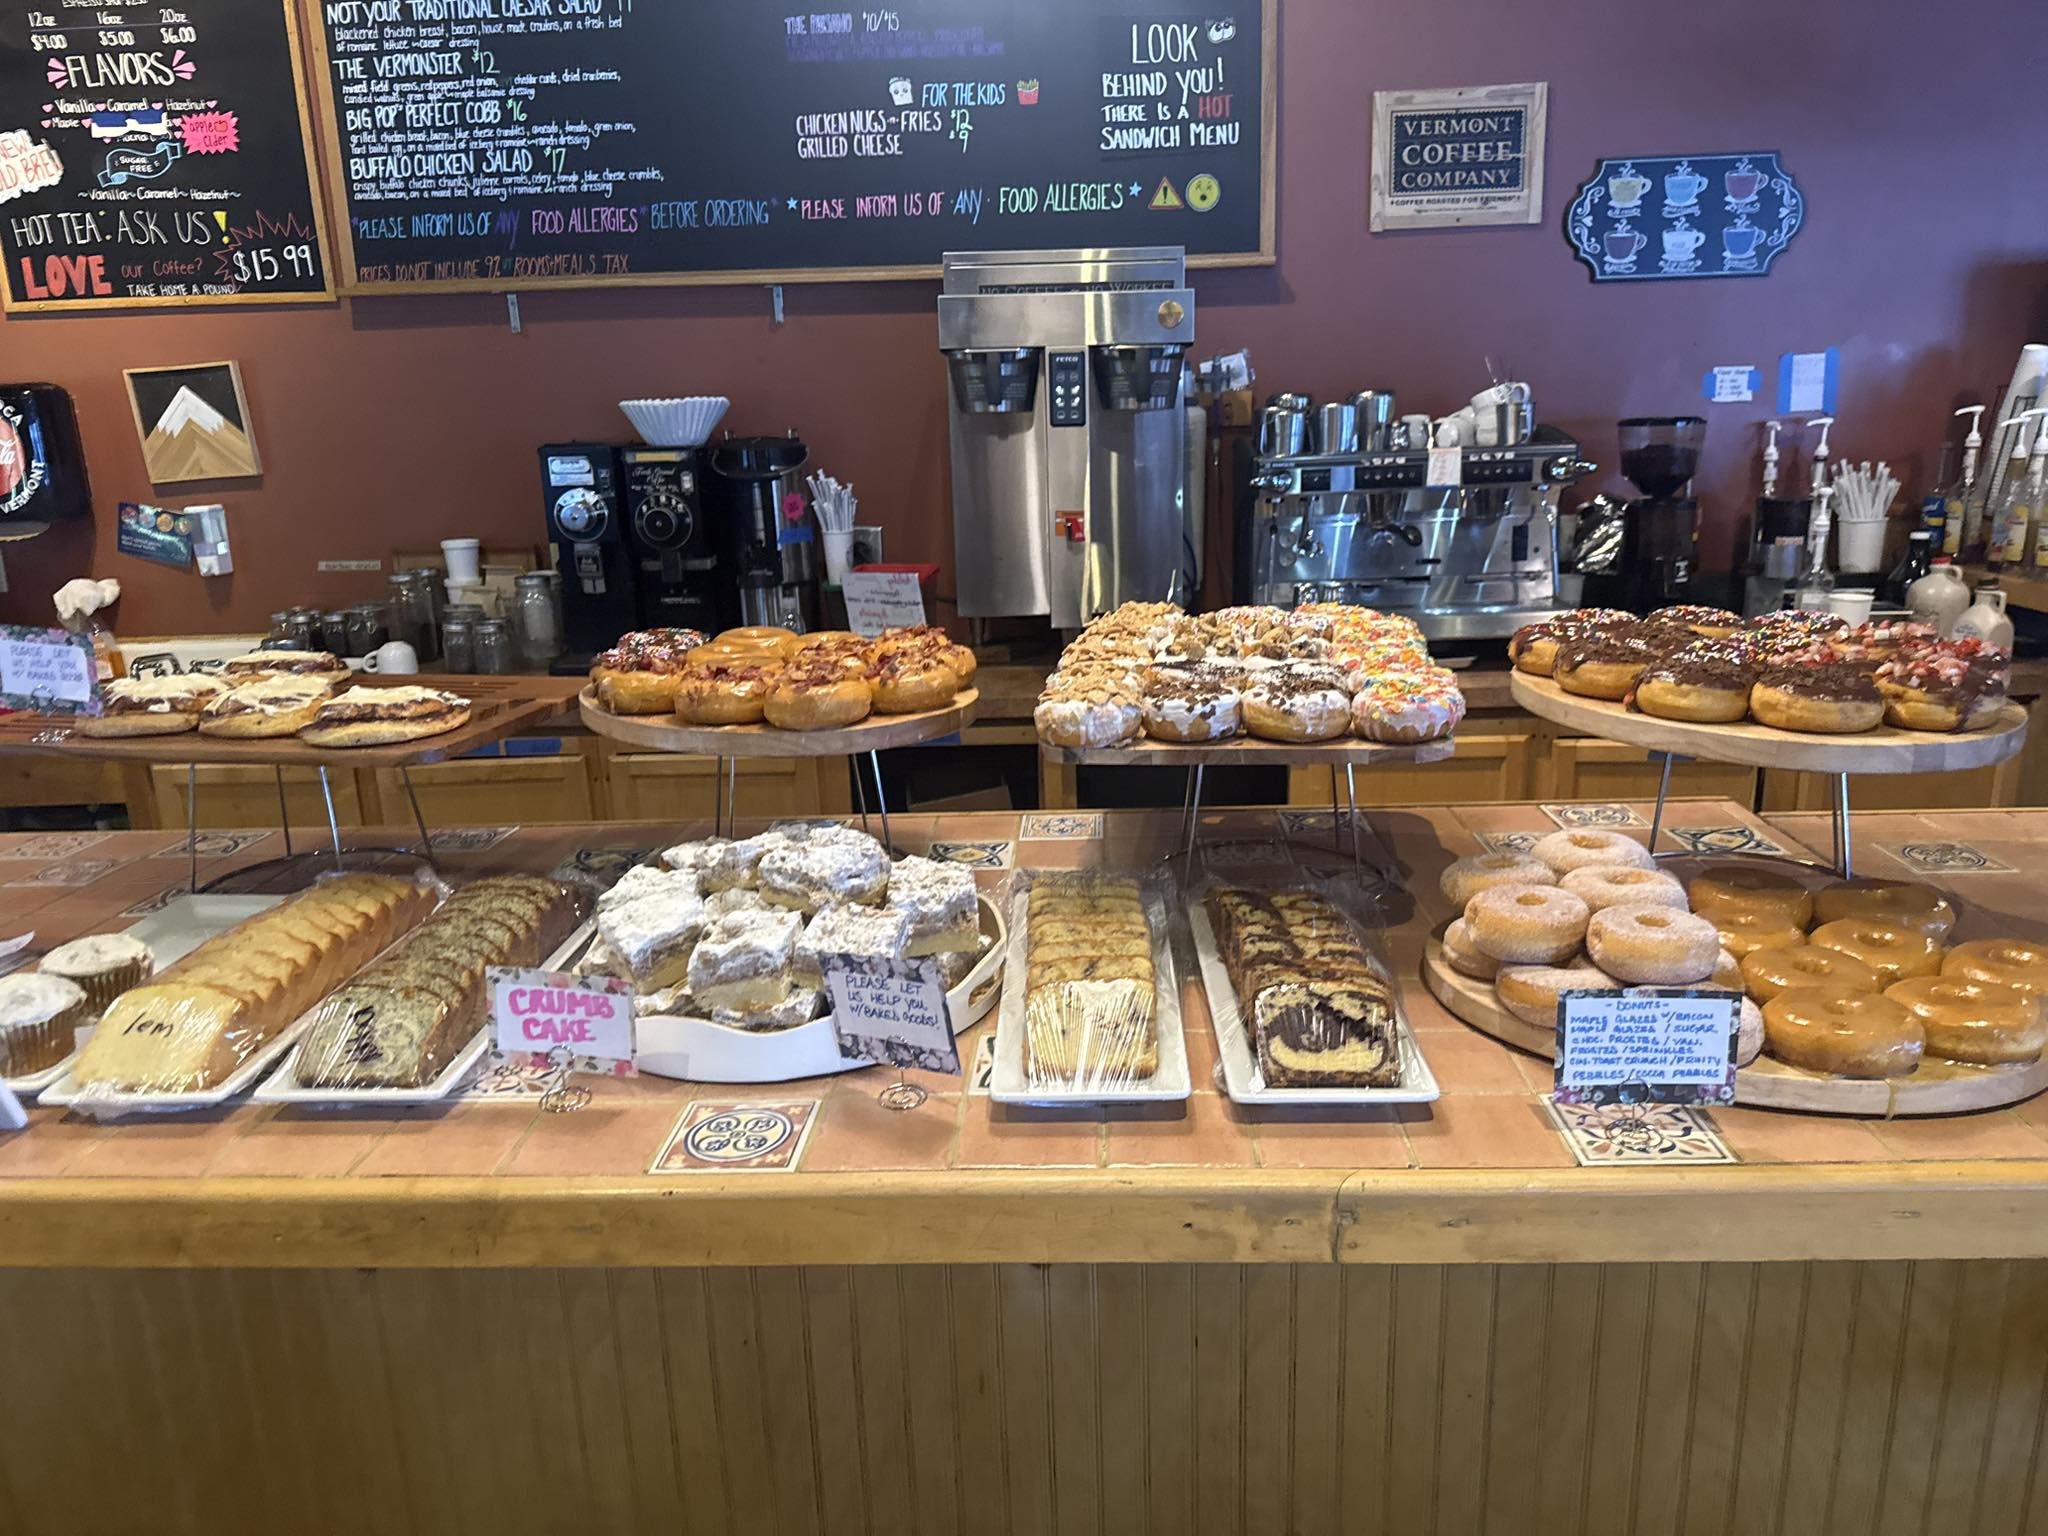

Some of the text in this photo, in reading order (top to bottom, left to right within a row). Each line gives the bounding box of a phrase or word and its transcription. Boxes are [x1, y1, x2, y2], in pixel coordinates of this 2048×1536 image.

[327, 2, 361, 25] NOT
[362, 1, 400, 27] YOUR
[406, 0, 497, 20] TRADITIONAL
[502, 0, 552, 17] CAESAR
[1132, 24, 1198, 64] LOOK
[65, 53, 175, 88] FLAVORS
[332, 49, 500, 80] THE VERMONSTER $12
[1102, 57, 1224, 104] BEHIND YOU!
[55, 97, 206, 114] Vanilla Caramel Hazelnut
[922, 83, 1005, 107] FOR THE KIDS
[346, 107, 372, 131] BIG
[406, 102, 461, 127] PERFECT
[465, 102, 501, 124] COBB
[506, 98, 528, 122] $16
[1101, 104, 1147, 122] THERE
[1177, 105, 1189, 119] A
[1199, 95, 1233, 118] HOT
[189, 120, 214, 133] apple
[796, 112, 847, 136] CHICKEN
[850, 110, 886, 134] NUGS
[901, 110, 942, 132] FRIES
[1100, 121, 1239, 150] SANDWICH MENU
[1404, 116, 1515, 136] VERMONT
[797, 135, 847, 158] GRILLED
[853, 134, 903, 156] CHEESE
[1402, 141, 1513, 165] COFFEE
[119, 156, 148, 164] SUGAR
[129, 164, 153, 173] FREE
[350, 147, 567, 180] BUFFALO CHICKEN SALAD $17
[1401, 169, 1511, 188] COMPANY
[90, 188, 128, 200] Vanilla
[136, 187, 178, 199] Caramel
[801, 183, 1123, 224] PLEASE INFORM US OF ANY FOOD ALLERGIES
[11, 214, 54, 247] HOT
[117, 210, 168, 245] ASK
[174, 210, 229, 245] US!
[360, 217, 407, 239] PLEASE
[411, 213, 453, 237] INFORM
[458, 212, 475, 236] US
[476, 211, 492, 236] OF
[532, 208, 564, 236] FOOD
[568, 206, 638, 234] ALLERGIES
[650, 201, 699, 230] BEFORE
[704, 199, 769, 227] ORDERING
[21, 245, 314, 299] LOVE our Coffee? $15.99
[603, 254, 629, 274] TAX
[127, 282, 235, 297] TAKE HOME A POUND
[0, 460, 45, 514] VERMONT
[846, 975, 922, 995] PLEASE LET
[508, 988, 615, 1019] CRUMB
[848, 991, 863, 1003] US
[870, 994, 900, 1006] HELP
[522, 1018, 597, 1043] CAKE
